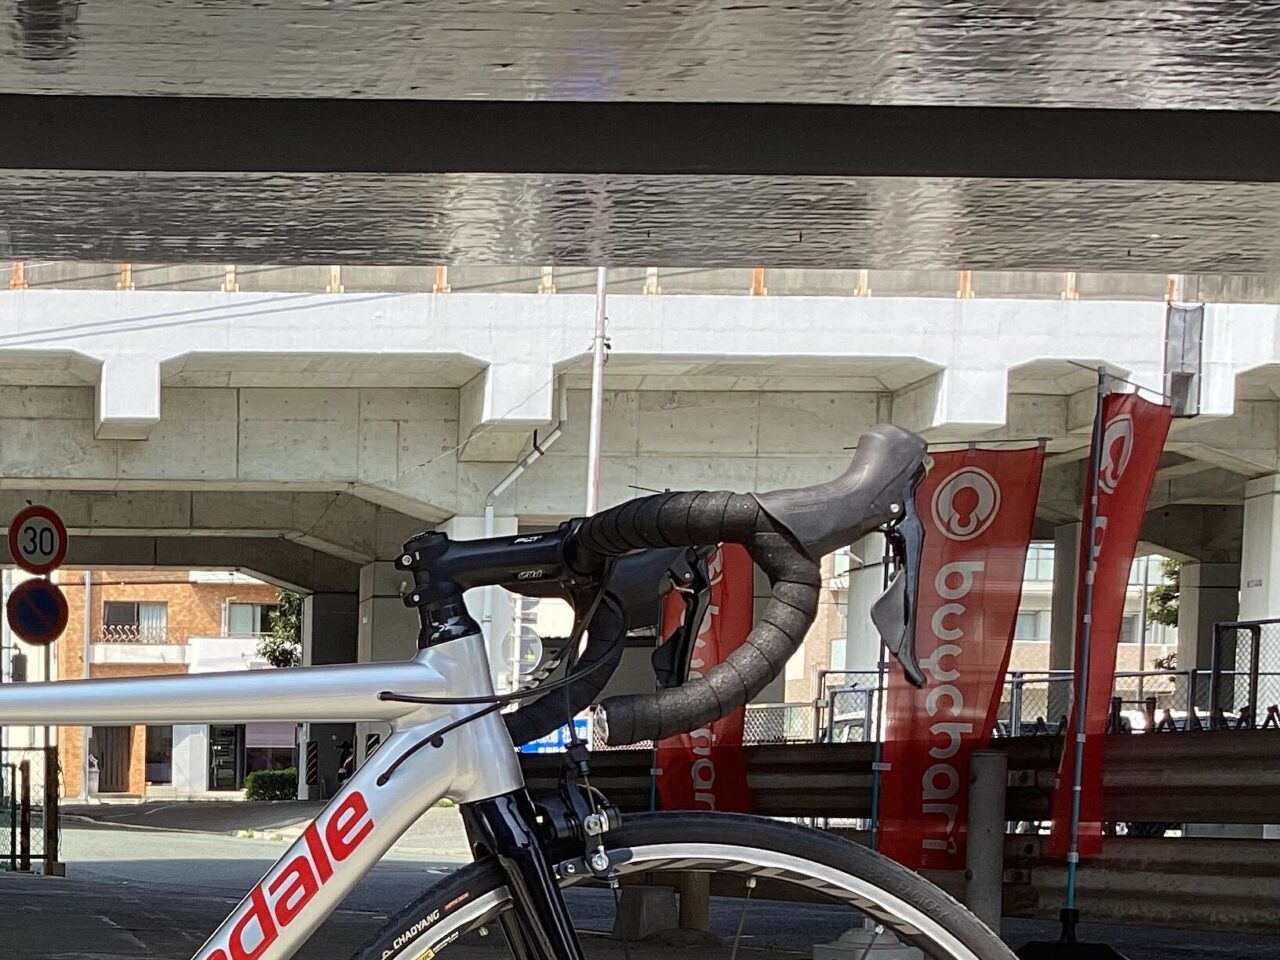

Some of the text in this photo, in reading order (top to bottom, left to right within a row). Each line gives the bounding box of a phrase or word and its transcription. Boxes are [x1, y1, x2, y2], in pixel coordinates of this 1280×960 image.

[23, 526, 54, 557] 30
[919, 561, 985, 854] buychari
[393, 909, 440, 949] CHAOYANG
